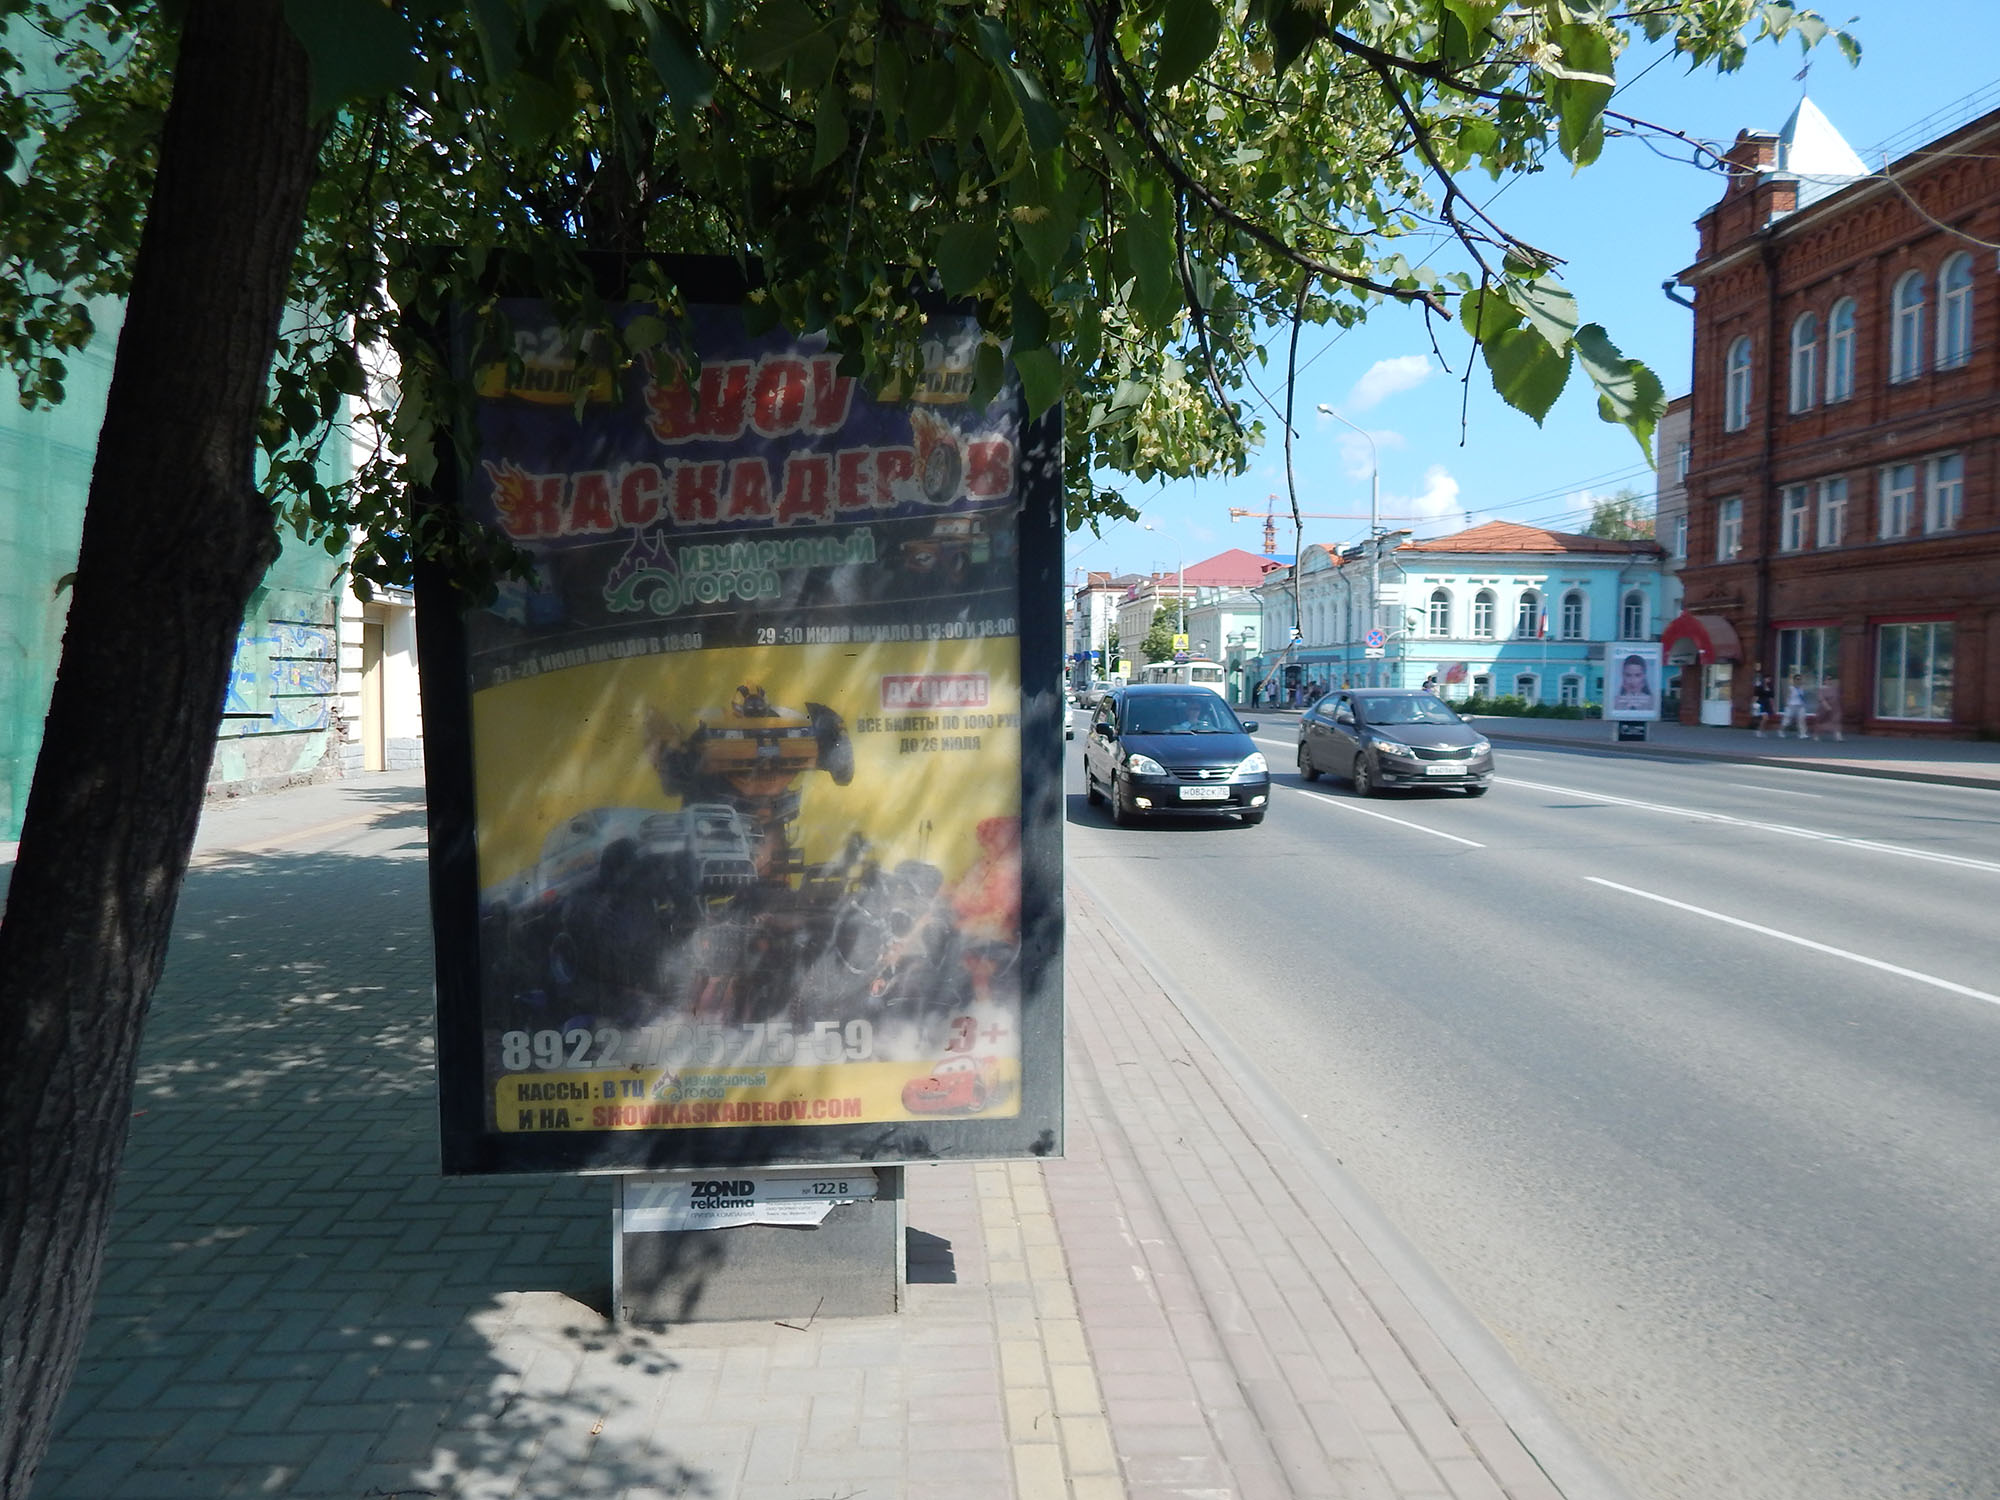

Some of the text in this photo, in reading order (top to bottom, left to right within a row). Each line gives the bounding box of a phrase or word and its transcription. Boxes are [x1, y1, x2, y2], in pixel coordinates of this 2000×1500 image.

[679, 527, 876, 574] ИЗУМРУДНЫЙ
[680, 570, 781, 604] ГОРОД
[757, 628, 776, 644] 29
[806, 625, 850, 643] ИЮЛЯ
[853, 624, 910, 642] НАЧАЛО
[912, 624, 923, 640] В
[926, 621, 963, 640] 13:00
[965, 621, 976, 638] И
[978, 617, 1016, 635] 18:00
[541, 649, 587, 671] ИЮЛЯ
[588, 637, 647, 661] НАЧАЛО
[649, 635, 660, 653] В
[663, 632, 703, 651] 18:00
[887, 679, 986, 705] АКЦИЯ!
[857, 717, 882, 733] ВСЕ
[885, 715, 939, 732] БИЛЕТЫ
[942, 715, 960, 730] ПО
[963, 714, 993, 730] 1000
[900, 737, 919, 754] ДО
[941, 735, 981, 751] ИЮЛЯ
[948, 1015, 1010, 1053] 3+
[604, 1080, 615, 1099] В
[620, 1079, 645, 1098] ТЦ
[684, 1072, 767, 1087] ИЗУМРУДНЫЙ
[684, 1088, 725, 1099] ГОРОД
[518, 1109, 534, 1130] И
[540, 1108, 570, 1129] НА
[592, 1097, 863, 1128] SHOWKASKADEROV.COM
[691, 1181, 755, 1197] ZOND
[811, 1182, 836, 1195] 122
[691, 1197, 754, 1210] reklama
